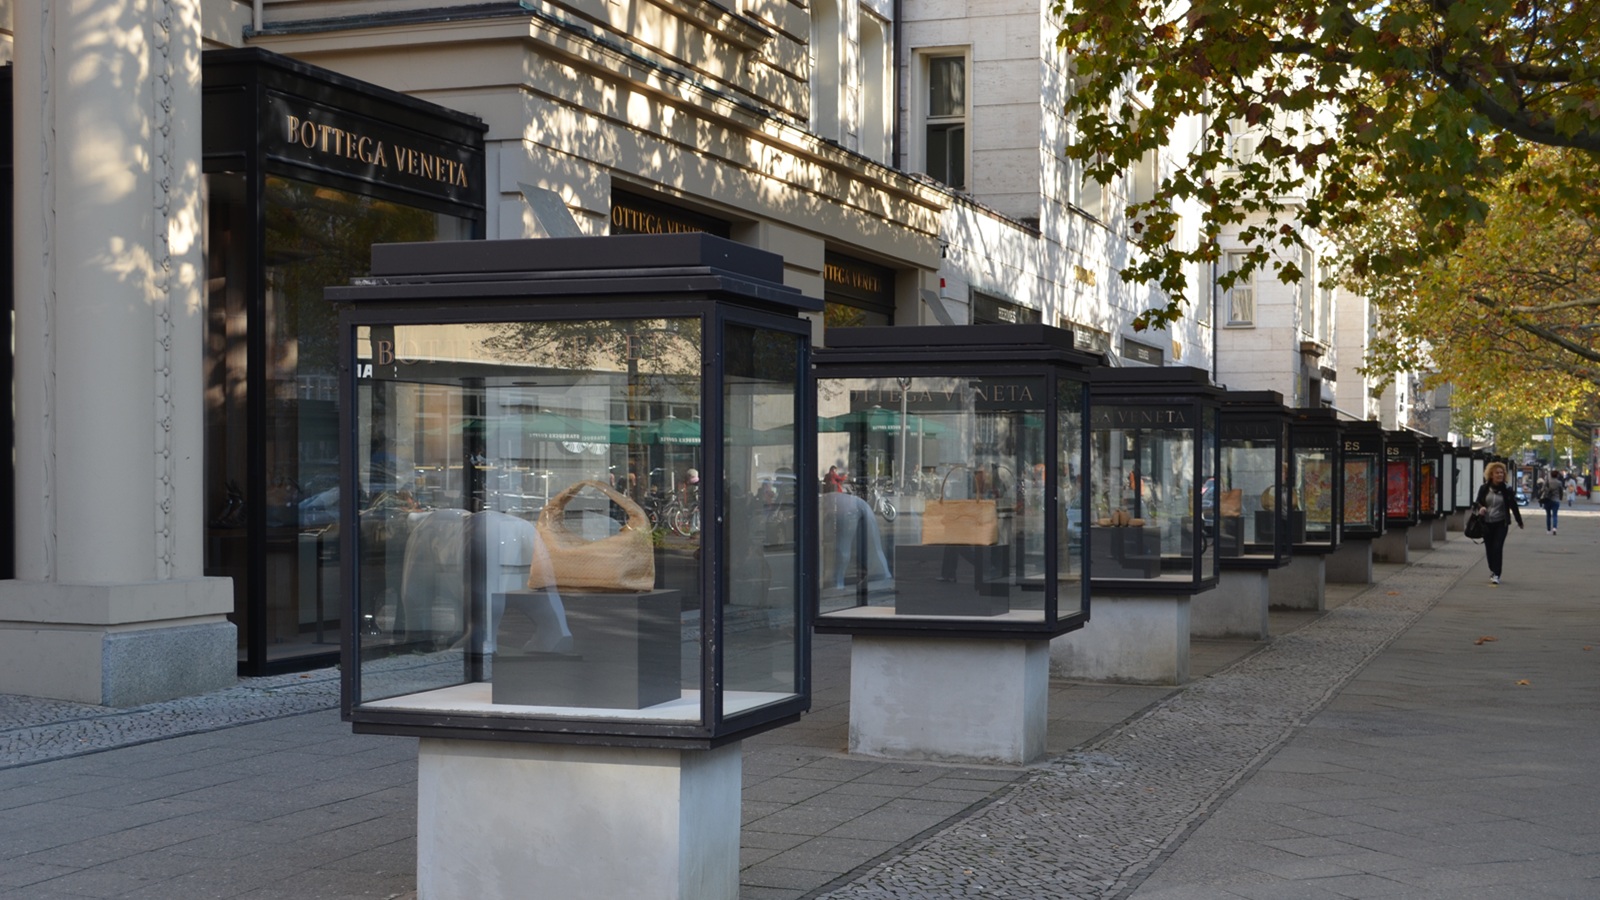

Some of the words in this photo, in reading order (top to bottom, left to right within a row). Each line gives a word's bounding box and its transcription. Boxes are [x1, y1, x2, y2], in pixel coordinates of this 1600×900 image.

[287, 115, 388, 168] BOTTEGA
[394, 144, 469, 188] VENETA
[1118, 410, 1185, 423] VENETA
